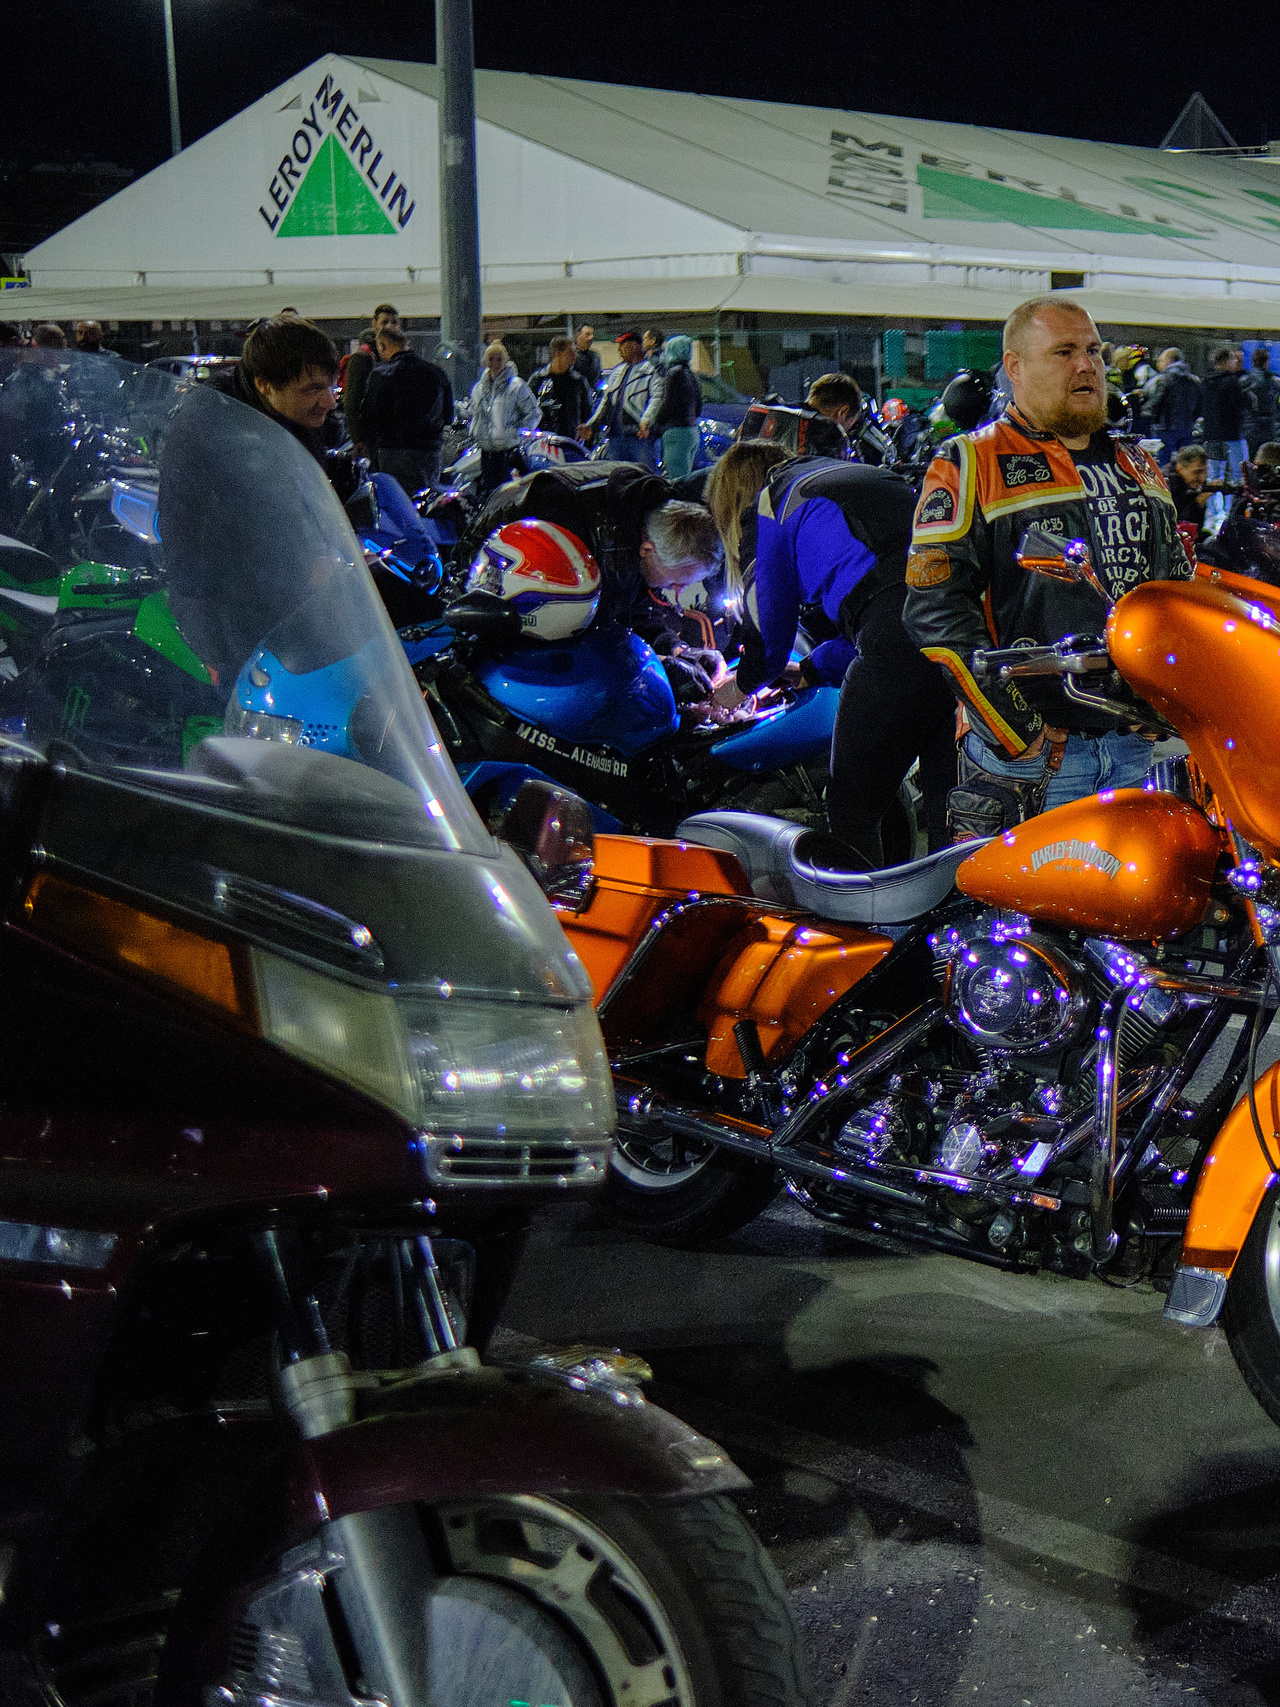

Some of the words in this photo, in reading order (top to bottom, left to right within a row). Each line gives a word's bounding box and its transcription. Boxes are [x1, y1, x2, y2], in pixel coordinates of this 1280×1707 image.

[259, 102, 323, 232] LEROY
[315, 74, 416, 228] MERLIN
[1097, 499, 1119, 513] OF
[1105, 566, 1138, 582] LUB
